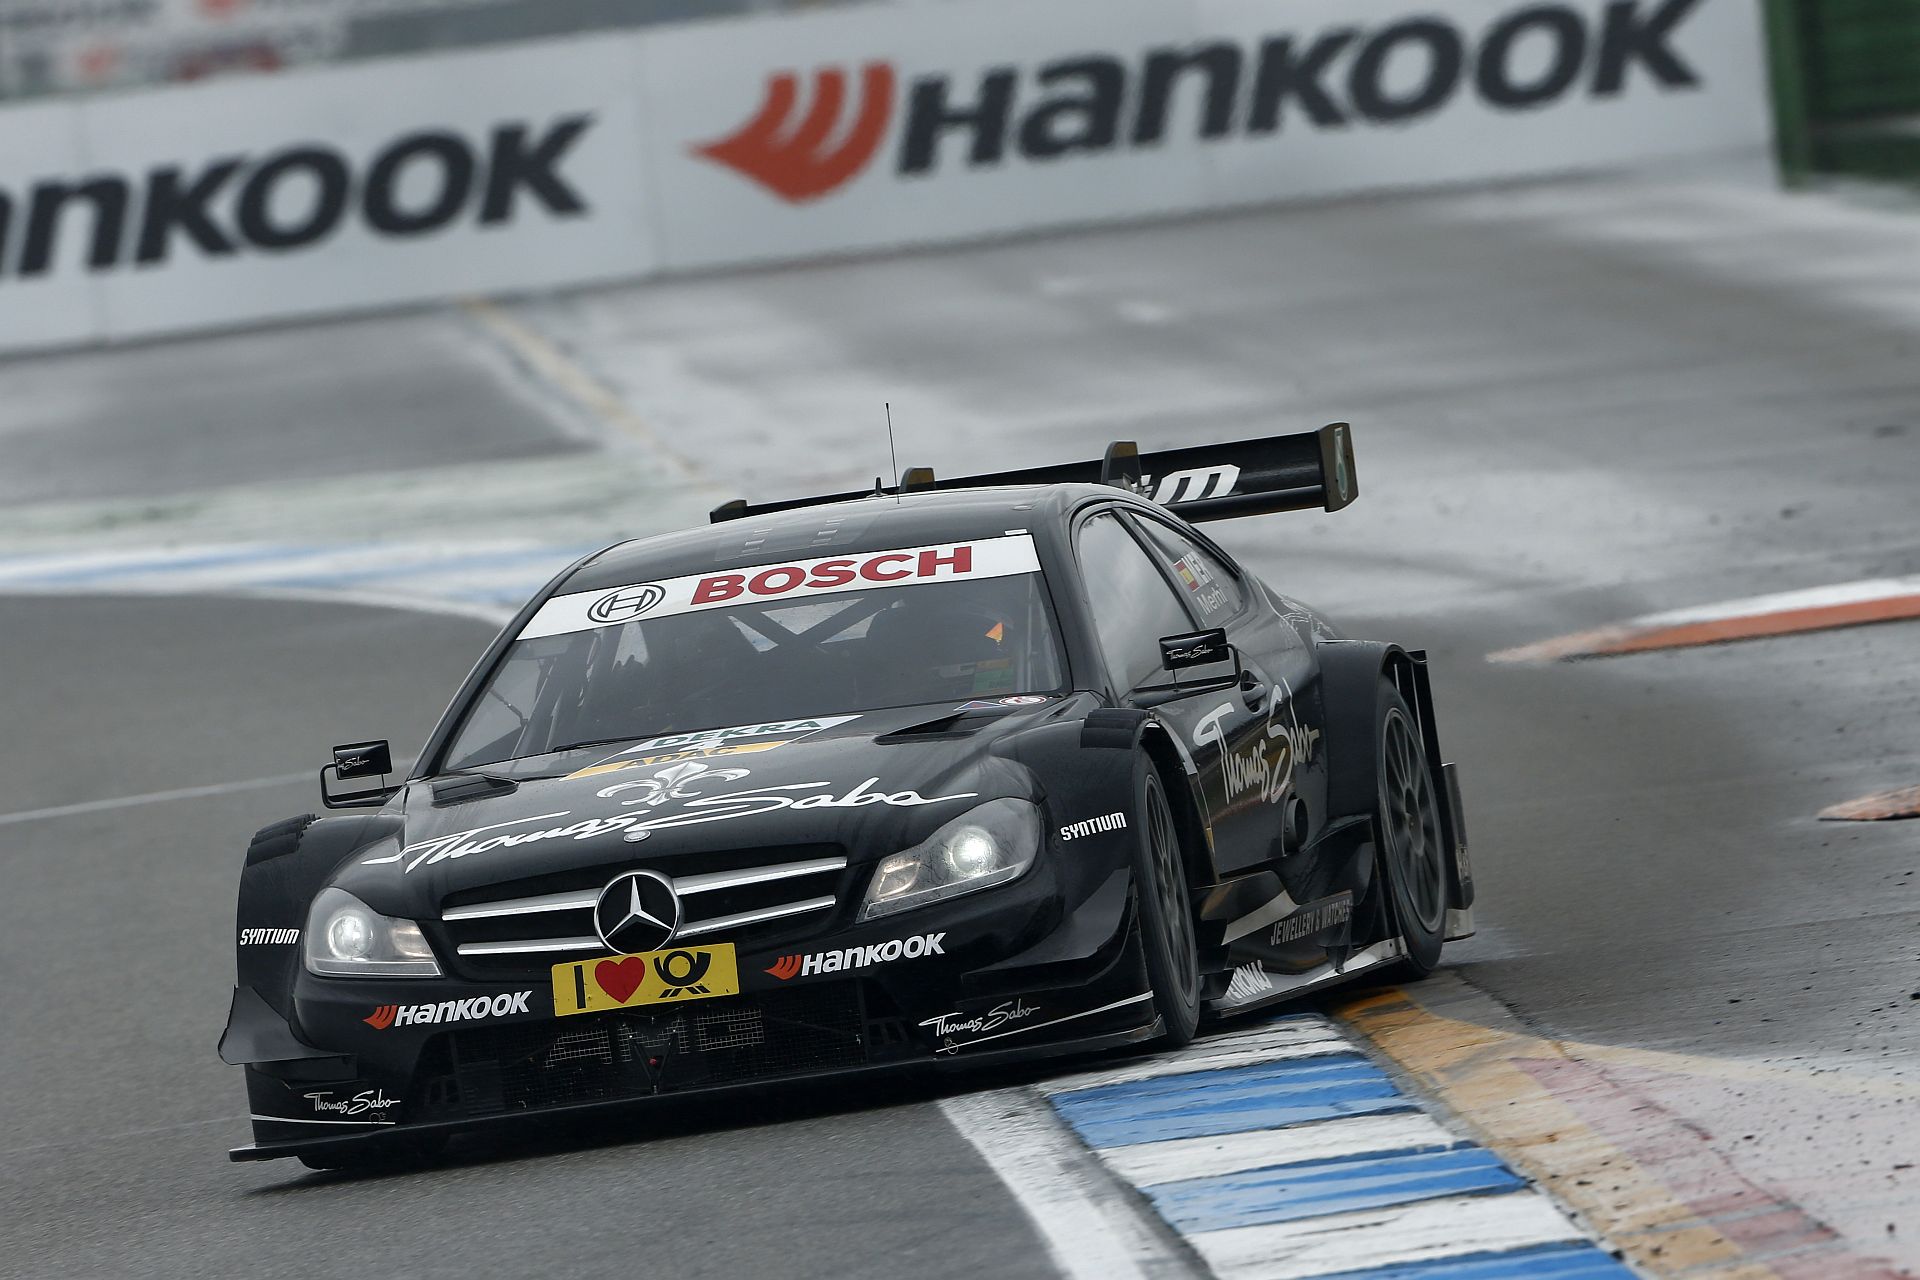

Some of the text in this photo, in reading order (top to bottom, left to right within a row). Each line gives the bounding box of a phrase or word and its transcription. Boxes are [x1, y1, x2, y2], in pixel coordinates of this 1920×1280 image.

[690, 545, 972, 606] BOSCH
[652, 720, 822, 747] DEKRA
[1192, 677, 1320, 805] Thomas Sabo
[616, 746, 739, 770] ADAC
[361, 777, 978, 874] Thomas Sabo
[1059, 811, 1128, 842] SYNTIUM
[239, 927, 299, 946] SYNTIUM
[1270, 911, 1314, 946] JEWELLERY
[1321, 898, 1350, 929] WATCHES
[573, 964, 587, 1009] I
[1225, 959, 1273, 1001] ETRONAS
[543, 1008, 765, 1069] AMG
[918, 998, 1041, 1037] Thomas Sabo
[303, 1088, 400, 1114] Thomas Sabo
